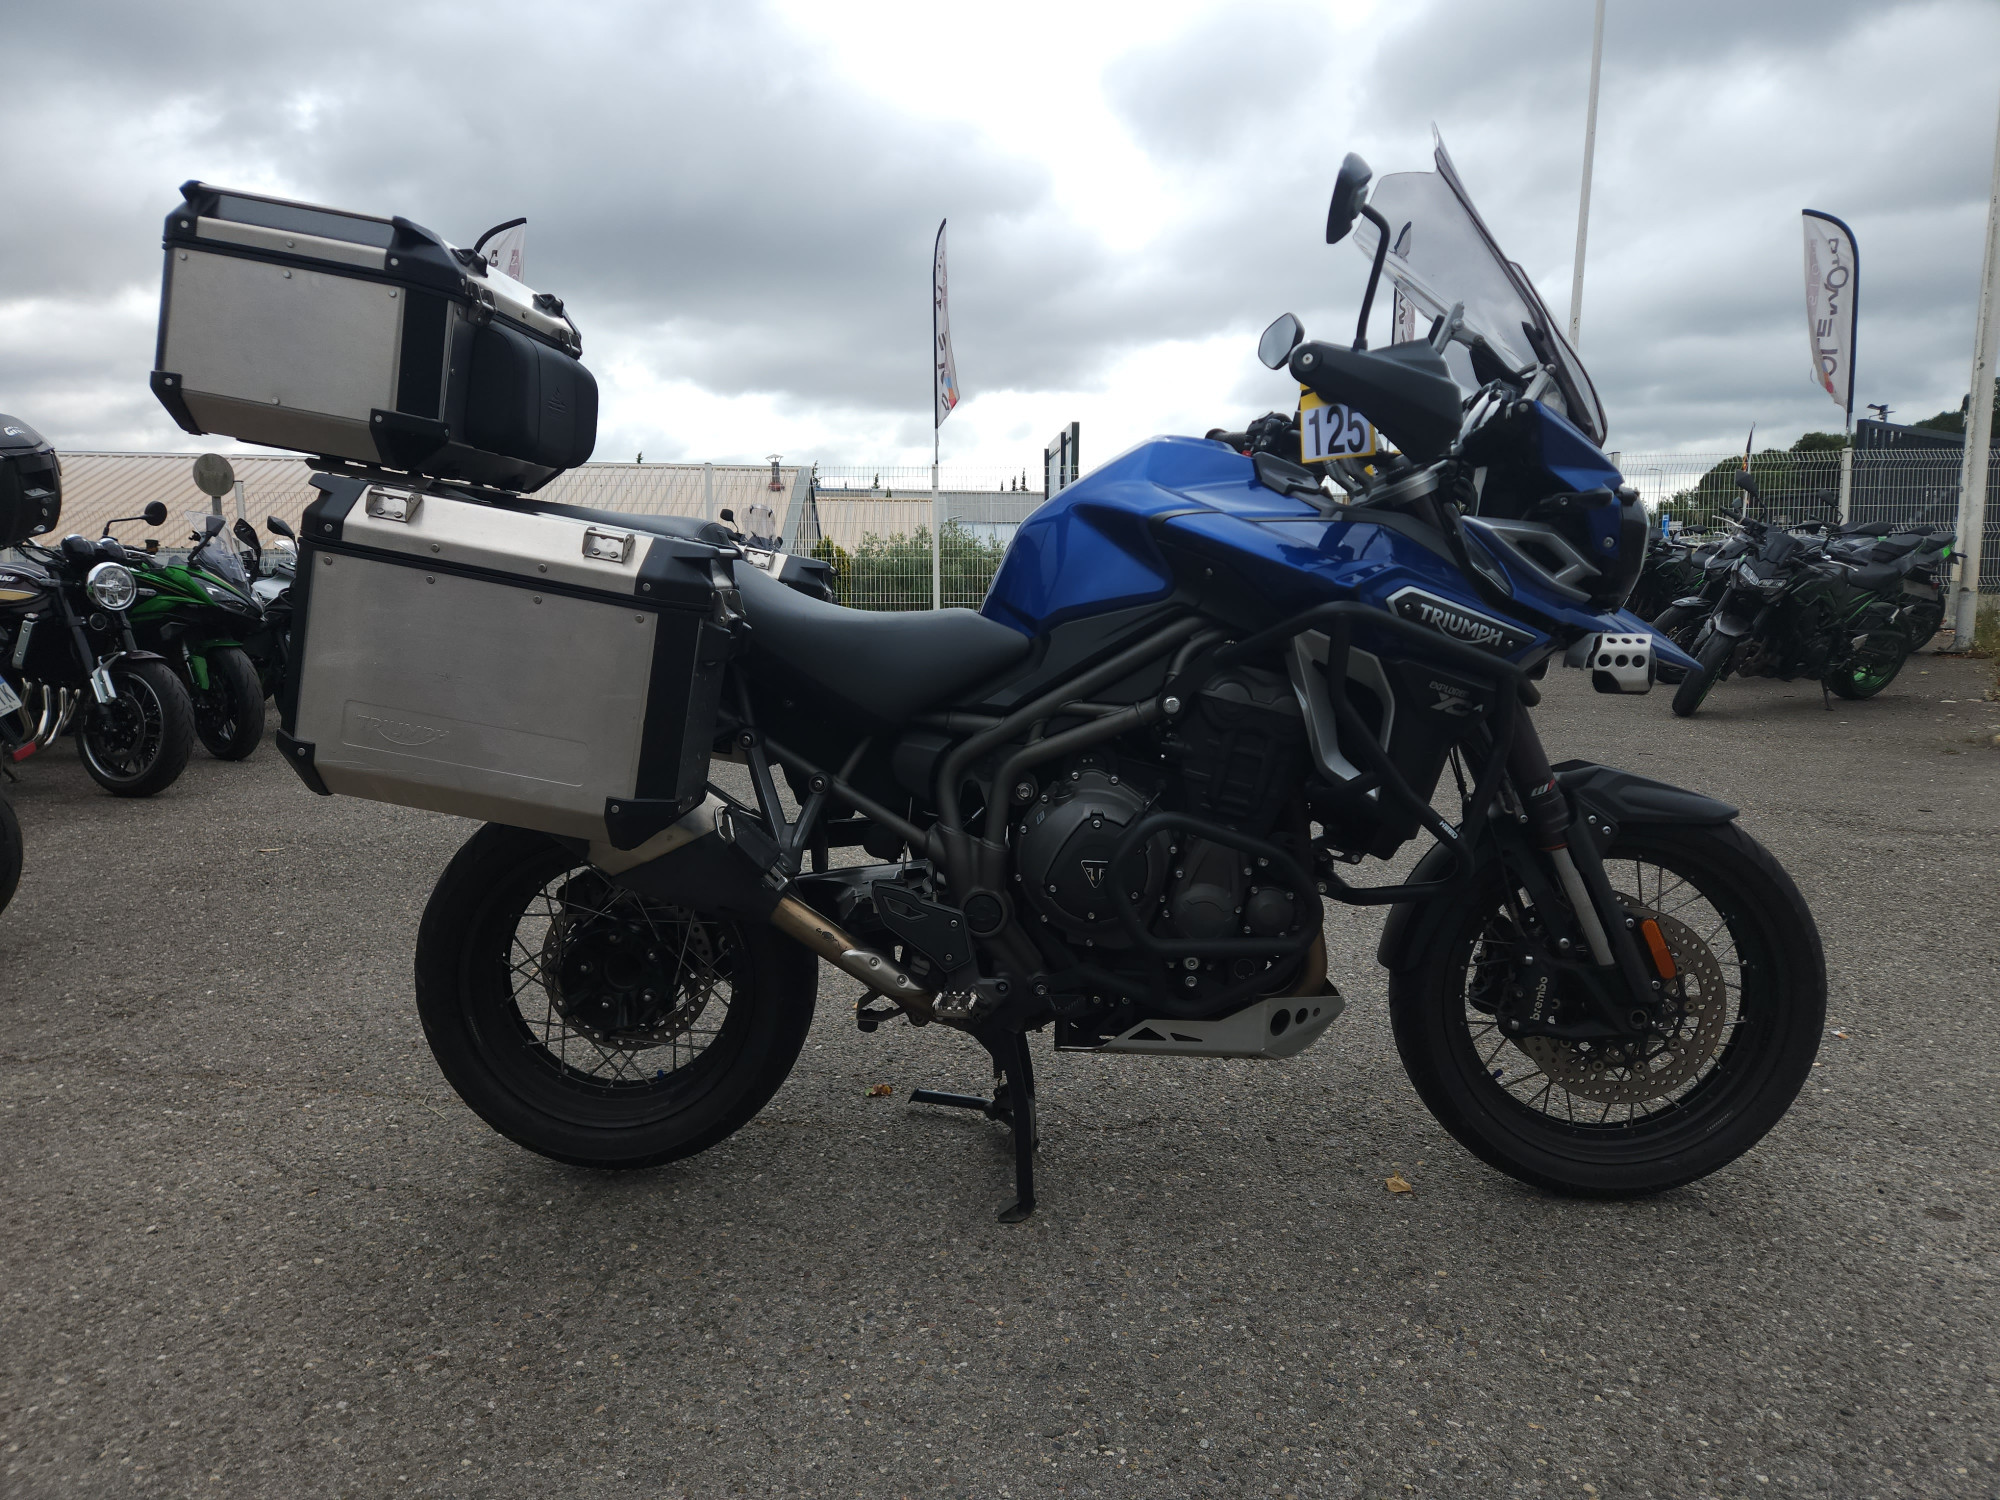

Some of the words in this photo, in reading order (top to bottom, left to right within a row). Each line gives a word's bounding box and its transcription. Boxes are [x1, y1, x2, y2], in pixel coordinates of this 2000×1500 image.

[1309, 405, 1365, 456] 125
[1420, 603, 1503, 646] TRIUMPH
[1529, 975, 1548, 1021] brembo
